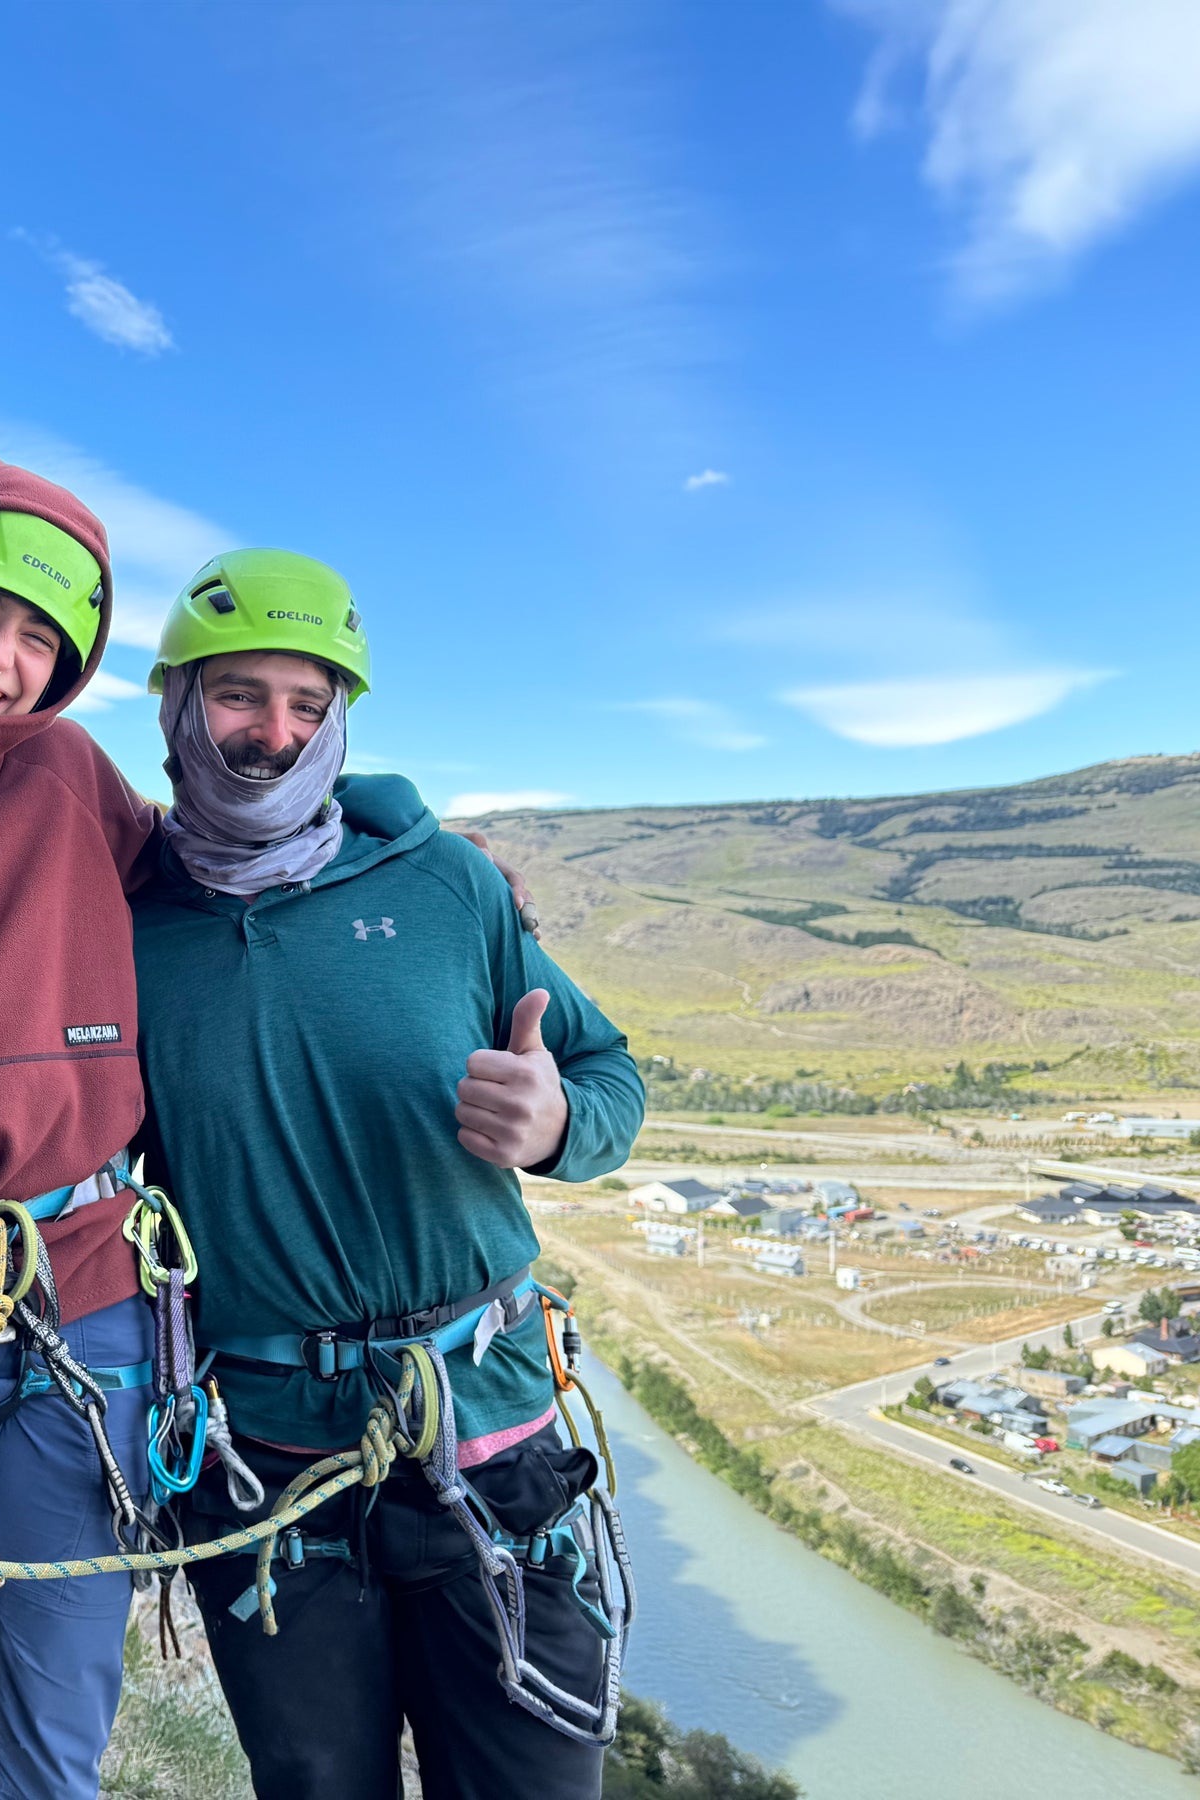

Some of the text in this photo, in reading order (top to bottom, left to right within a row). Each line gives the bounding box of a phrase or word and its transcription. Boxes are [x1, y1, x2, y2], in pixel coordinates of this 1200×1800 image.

[22, 554, 71, 590] EDELRID
[266, 610, 323, 626] EDELRID
[67, 1025, 119, 1041] MELANZANA
